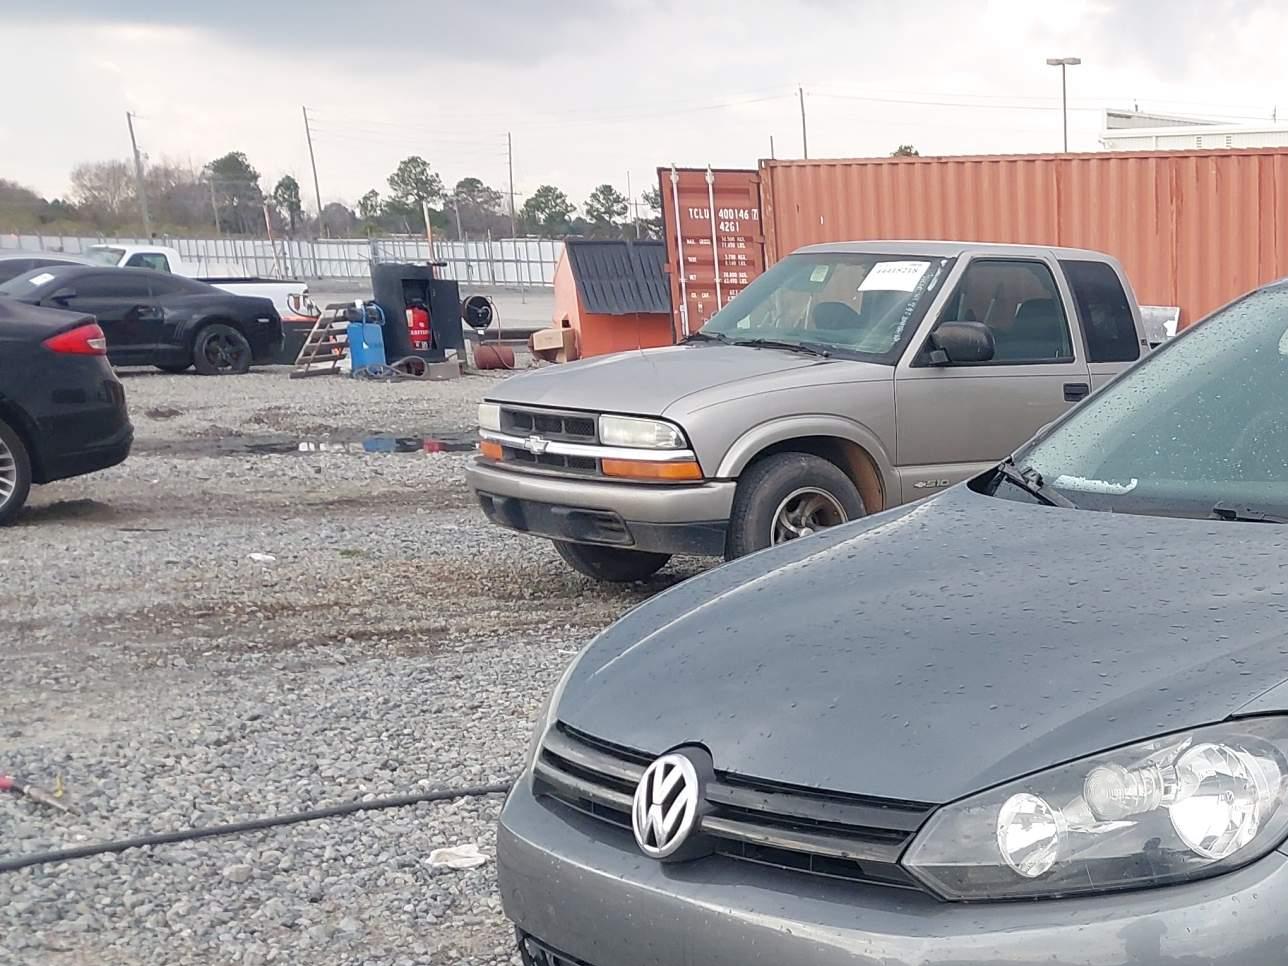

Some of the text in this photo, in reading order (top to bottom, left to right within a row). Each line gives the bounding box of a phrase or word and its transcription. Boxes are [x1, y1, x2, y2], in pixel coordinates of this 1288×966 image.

[688, 207, 710, 219] TCLU
[718, 208, 749, 220] 400146
[632, 754, 698, 858] VW
